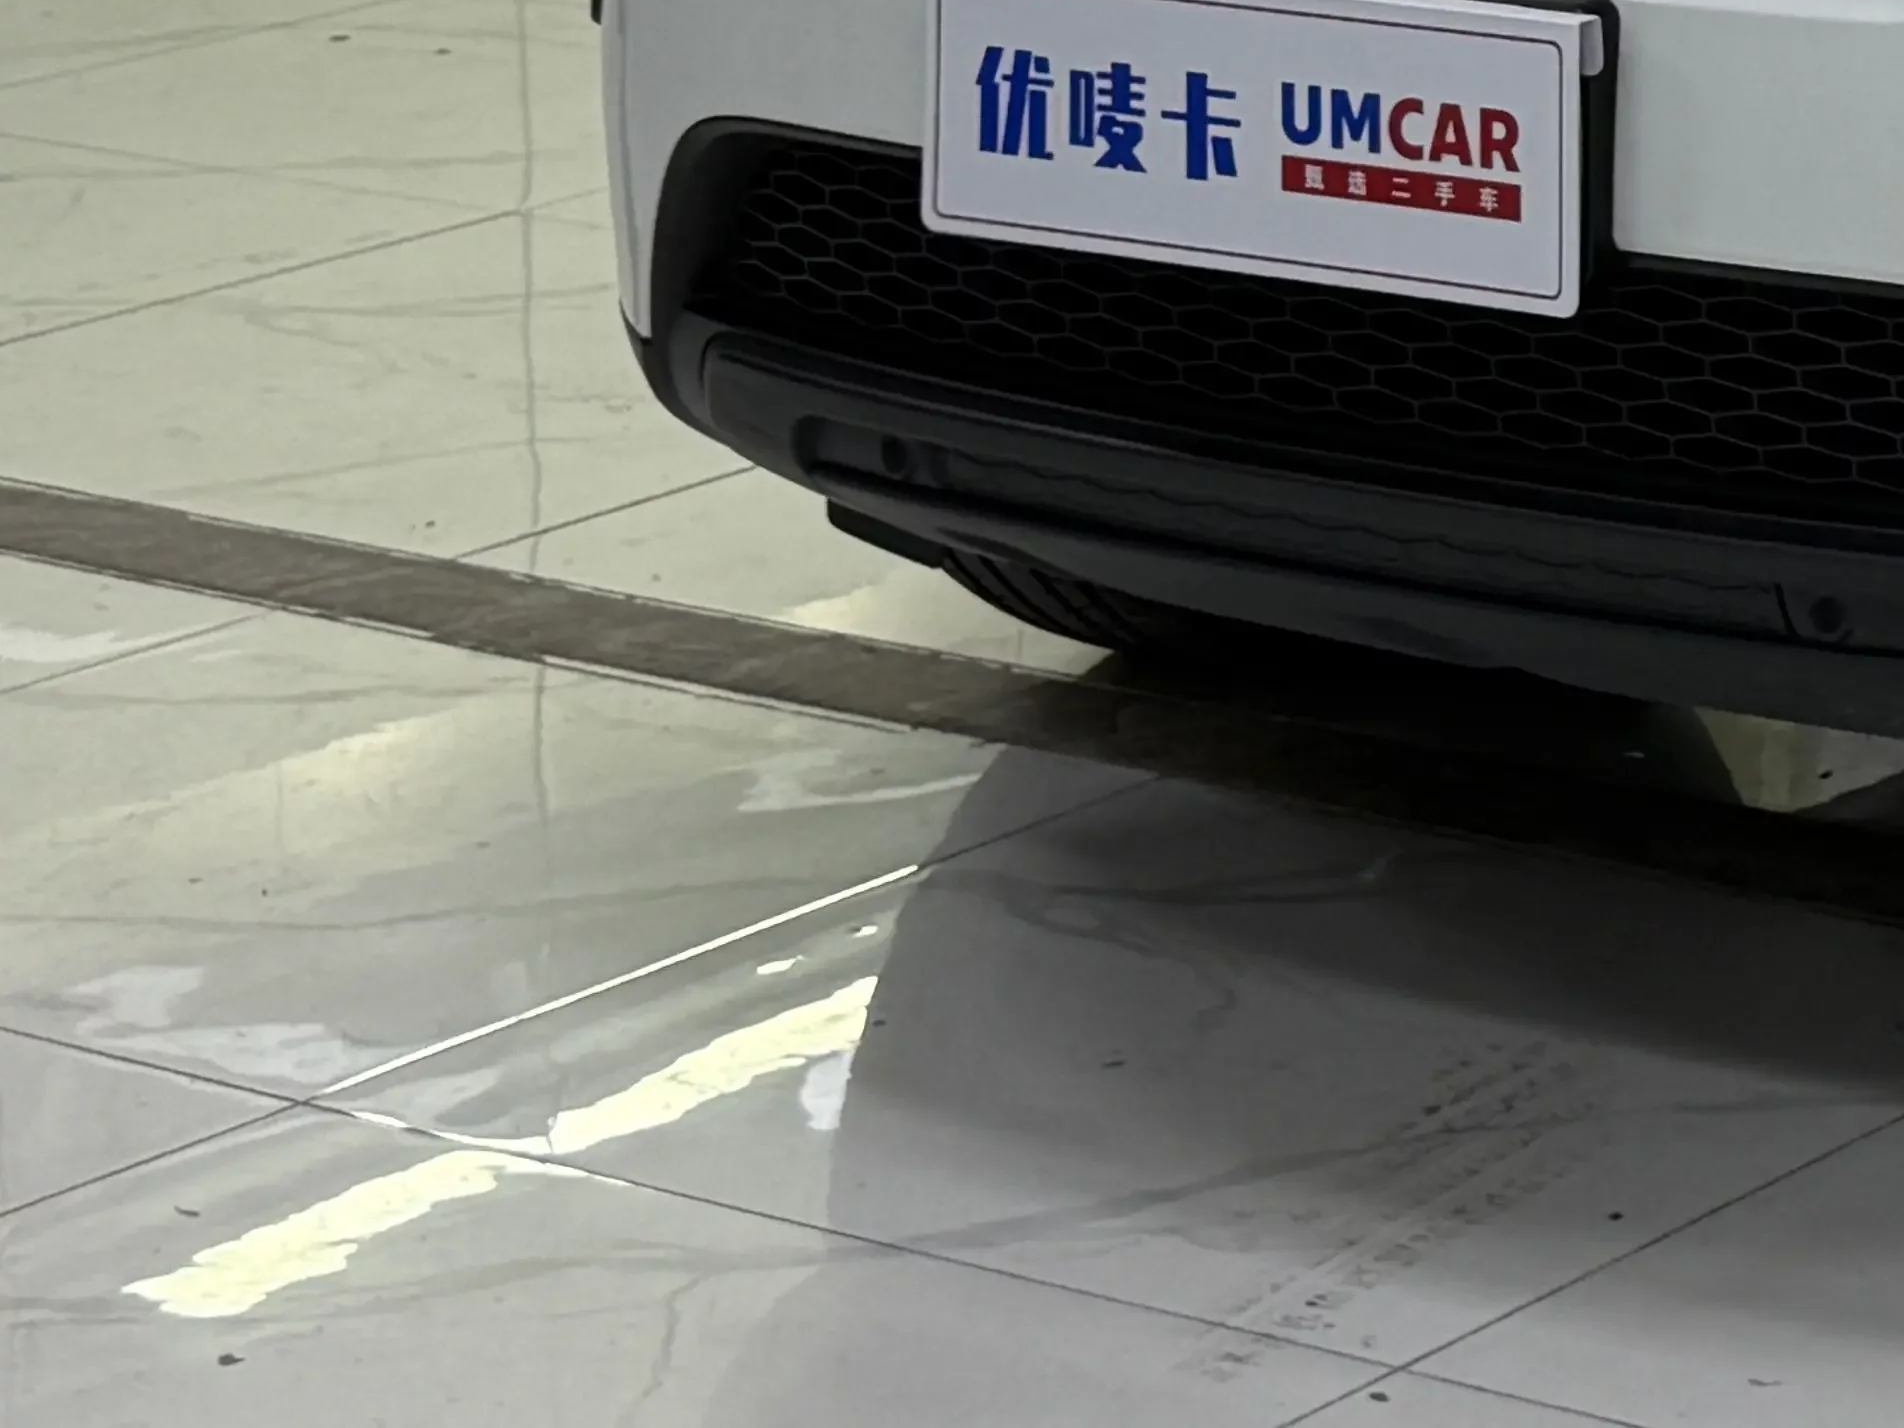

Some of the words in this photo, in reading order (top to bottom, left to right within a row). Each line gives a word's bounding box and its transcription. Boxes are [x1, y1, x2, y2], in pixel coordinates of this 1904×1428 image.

[975, 45, 1242, 180] 优唛卡
[1280, 81, 1521, 173] UMCAR
